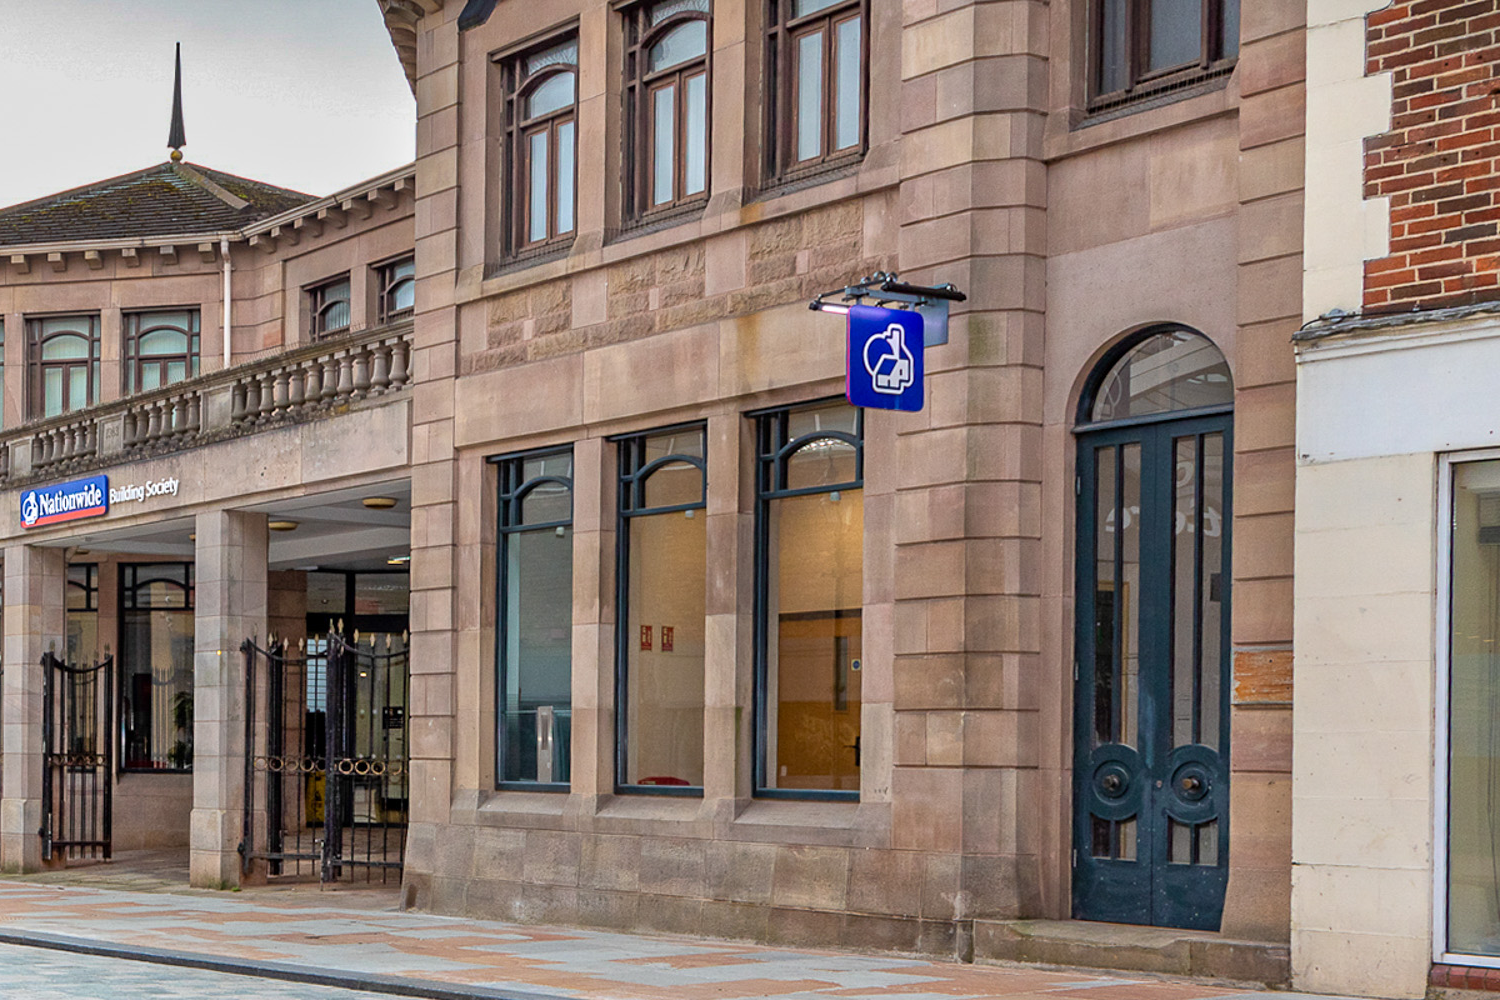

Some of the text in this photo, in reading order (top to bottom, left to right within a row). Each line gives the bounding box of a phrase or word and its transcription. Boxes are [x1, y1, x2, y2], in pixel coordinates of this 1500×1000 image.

[38, 476, 179, 516] Nationwide Building Society
